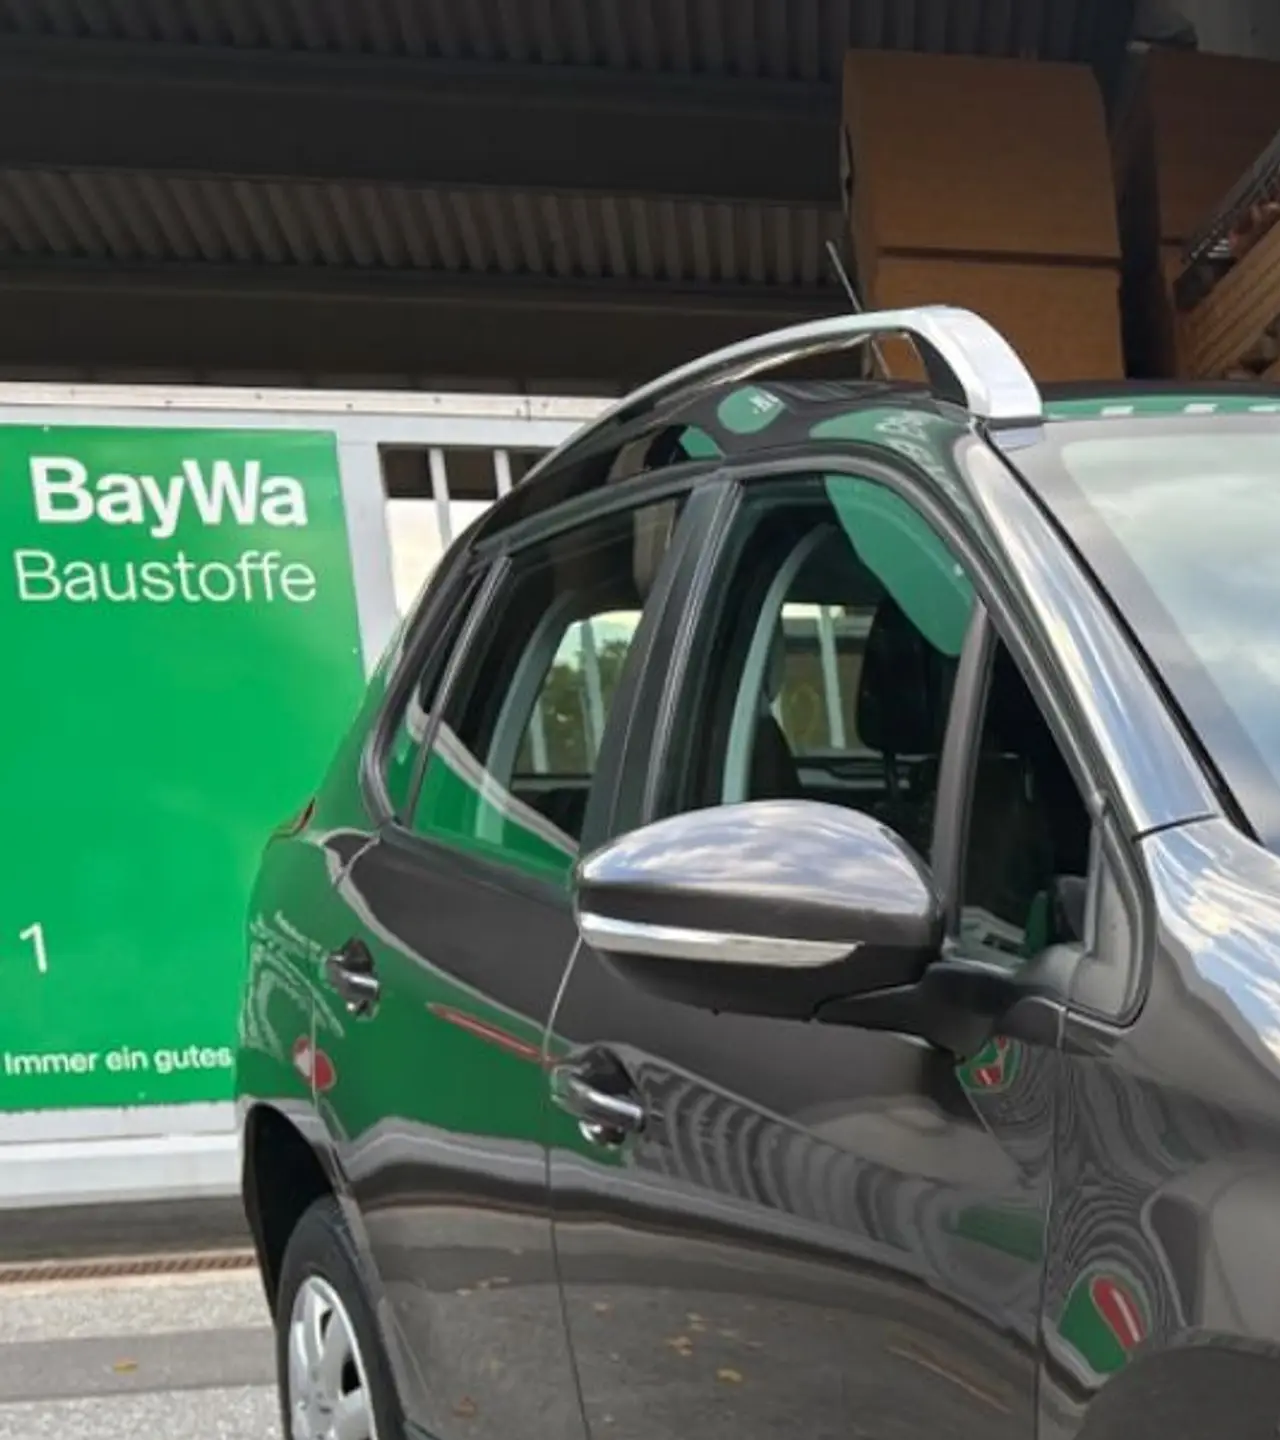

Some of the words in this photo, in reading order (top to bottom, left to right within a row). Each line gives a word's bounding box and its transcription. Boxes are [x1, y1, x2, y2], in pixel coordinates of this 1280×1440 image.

[29, 455, 309, 539] BayWa
[13, 548, 318, 603] Baustoffe
[19, 921, 49, 975] 1
[4, 1051, 98, 1076] Immer
[105, 1046, 149, 1072] ein
[154, 1045, 233, 1075] gutes
